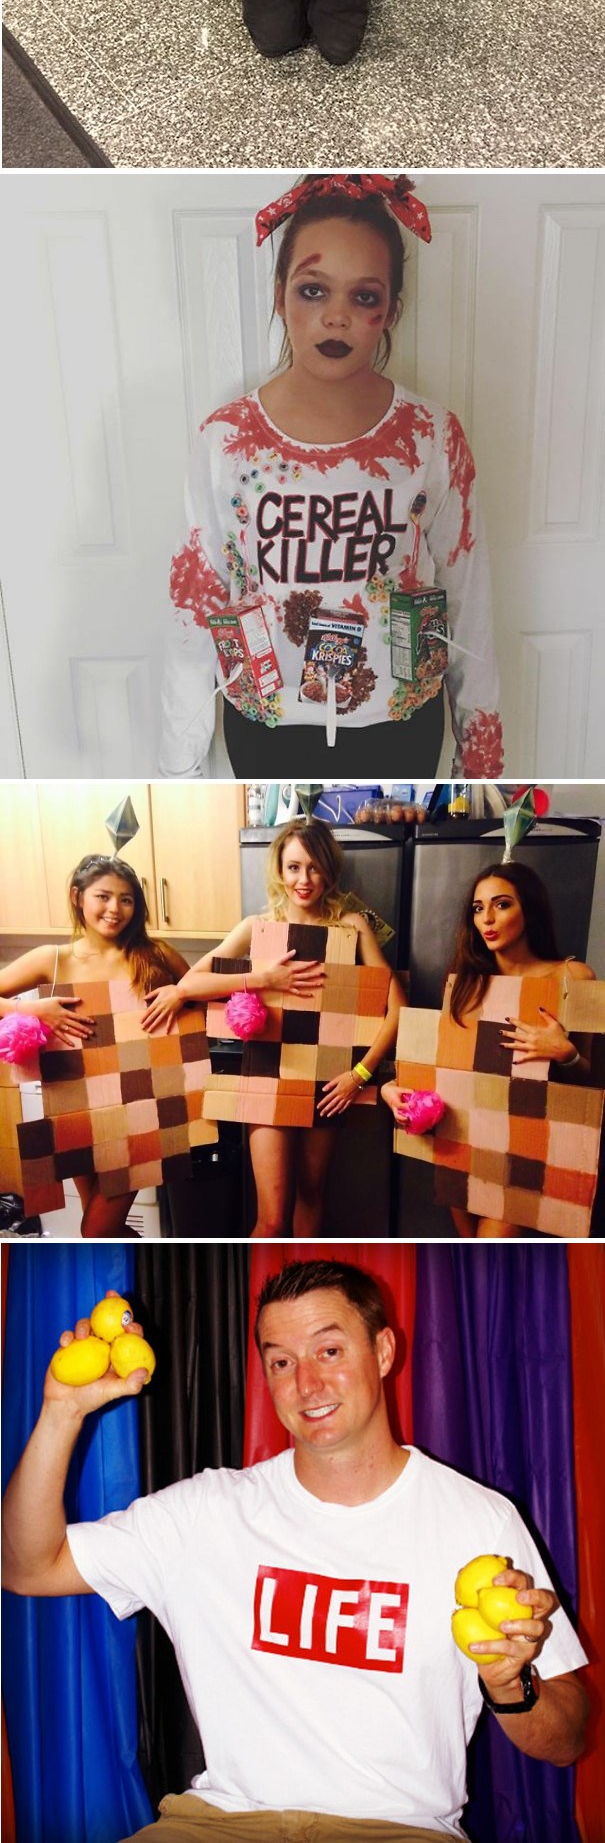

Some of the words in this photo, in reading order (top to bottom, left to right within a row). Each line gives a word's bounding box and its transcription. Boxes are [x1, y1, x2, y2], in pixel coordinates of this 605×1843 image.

[256, 488, 408, 543] CEREAL
[257, 533, 396, 585] KILLER
[311, 649, 352, 666] KRISPIES
[319, 642, 348, 654] COCOA
[259, 1576, 401, 1662] LIFE
